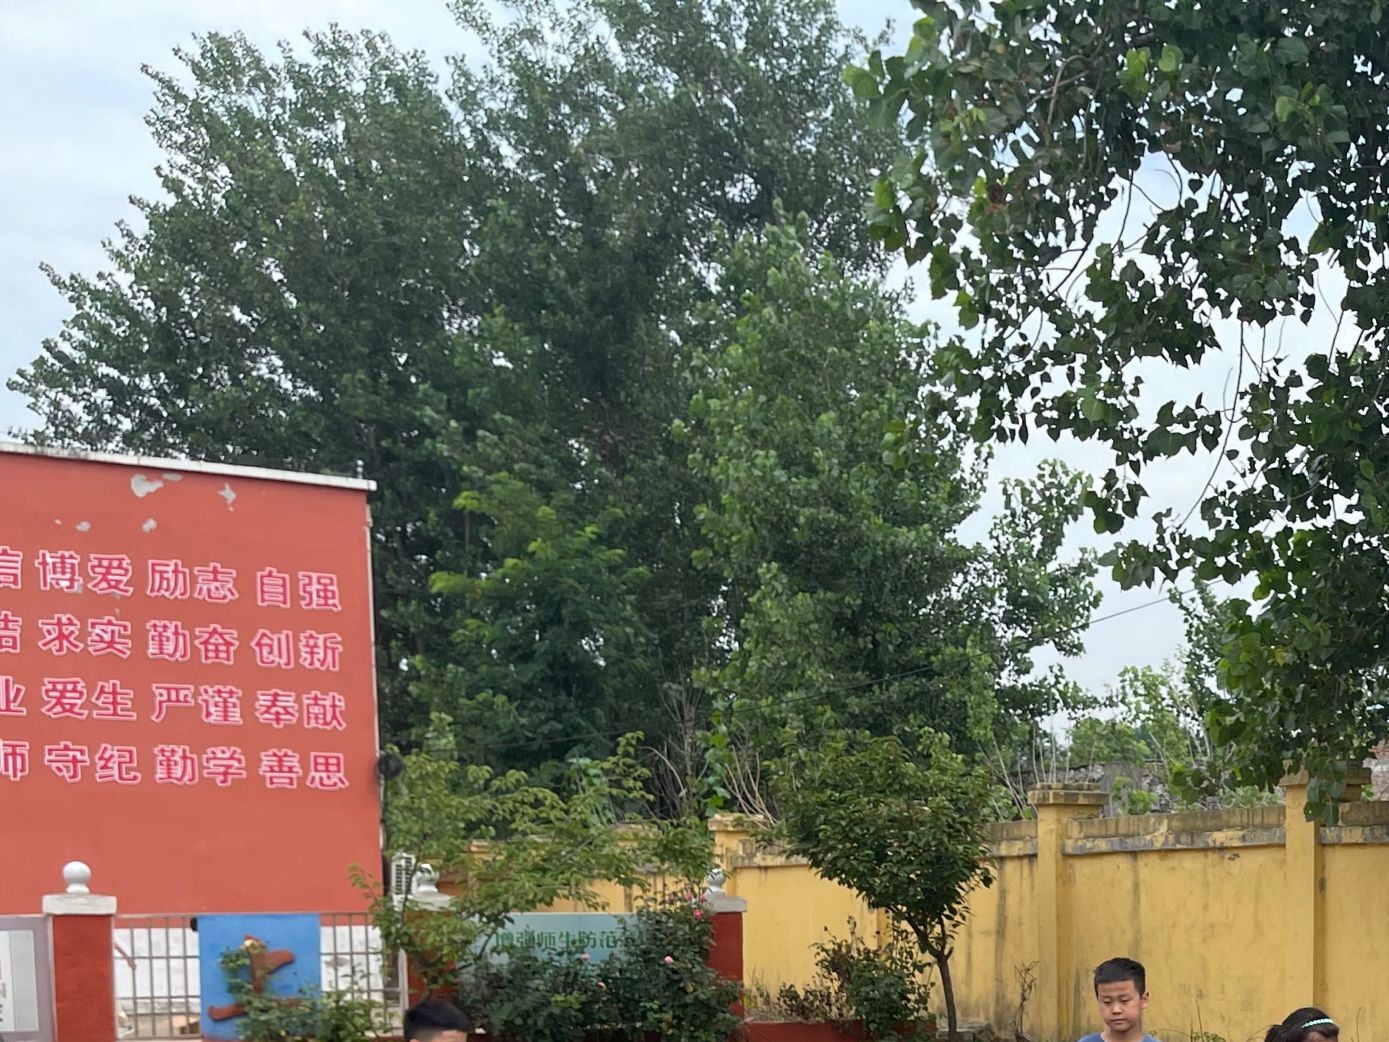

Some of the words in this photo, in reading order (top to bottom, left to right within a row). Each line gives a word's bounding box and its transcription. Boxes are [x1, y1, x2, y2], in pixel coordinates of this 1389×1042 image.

[35, 550, 134, 596] 博爱
[147, 560, 238, 602] 励志
[256, 567, 341, 611] 自强
[38, 614, 132, 659] 求实
[146, 620, 239, 664] 勤奋
[251, 629, 343, 671] 创新
[41, 677, 136, 721] 爱生
[151, 684, 242, 725] 严谨
[255, 689, 346, 731] 奉献
[45, 741, 141, 784] 守纪
[154, 746, 246, 786] 勤学
[259, 749, 348, 789] 善思
